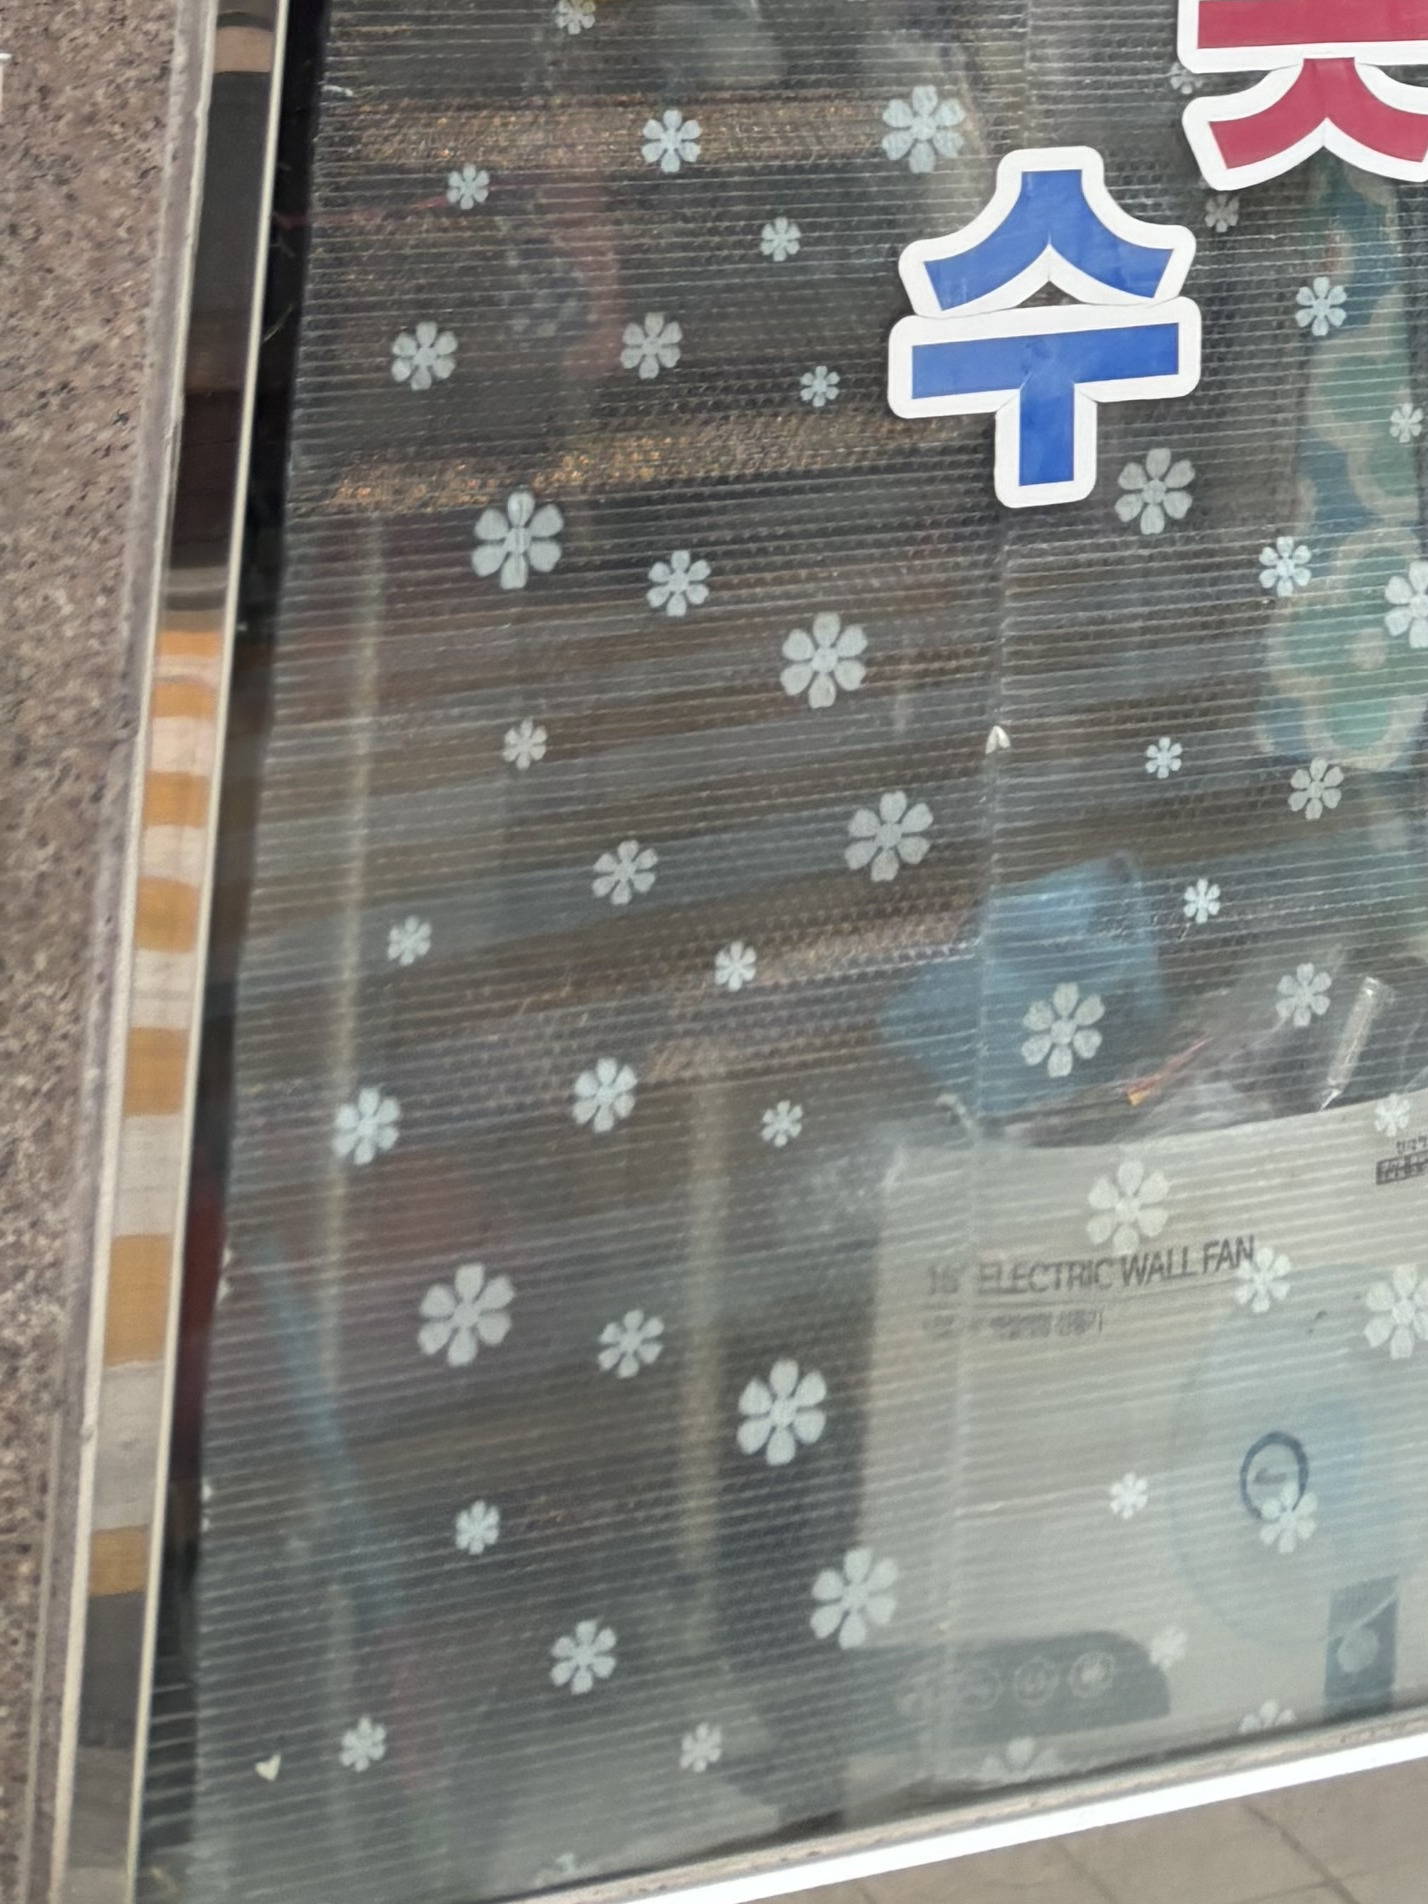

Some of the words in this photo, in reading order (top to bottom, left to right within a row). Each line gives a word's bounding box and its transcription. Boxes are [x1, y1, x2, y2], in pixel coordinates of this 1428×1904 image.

[978, 1255, 1114, 1296] ELECTRIC
[1121, 1246, 1197, 1287] WALL
[1202, 1235, 1255, 1275] FAN
